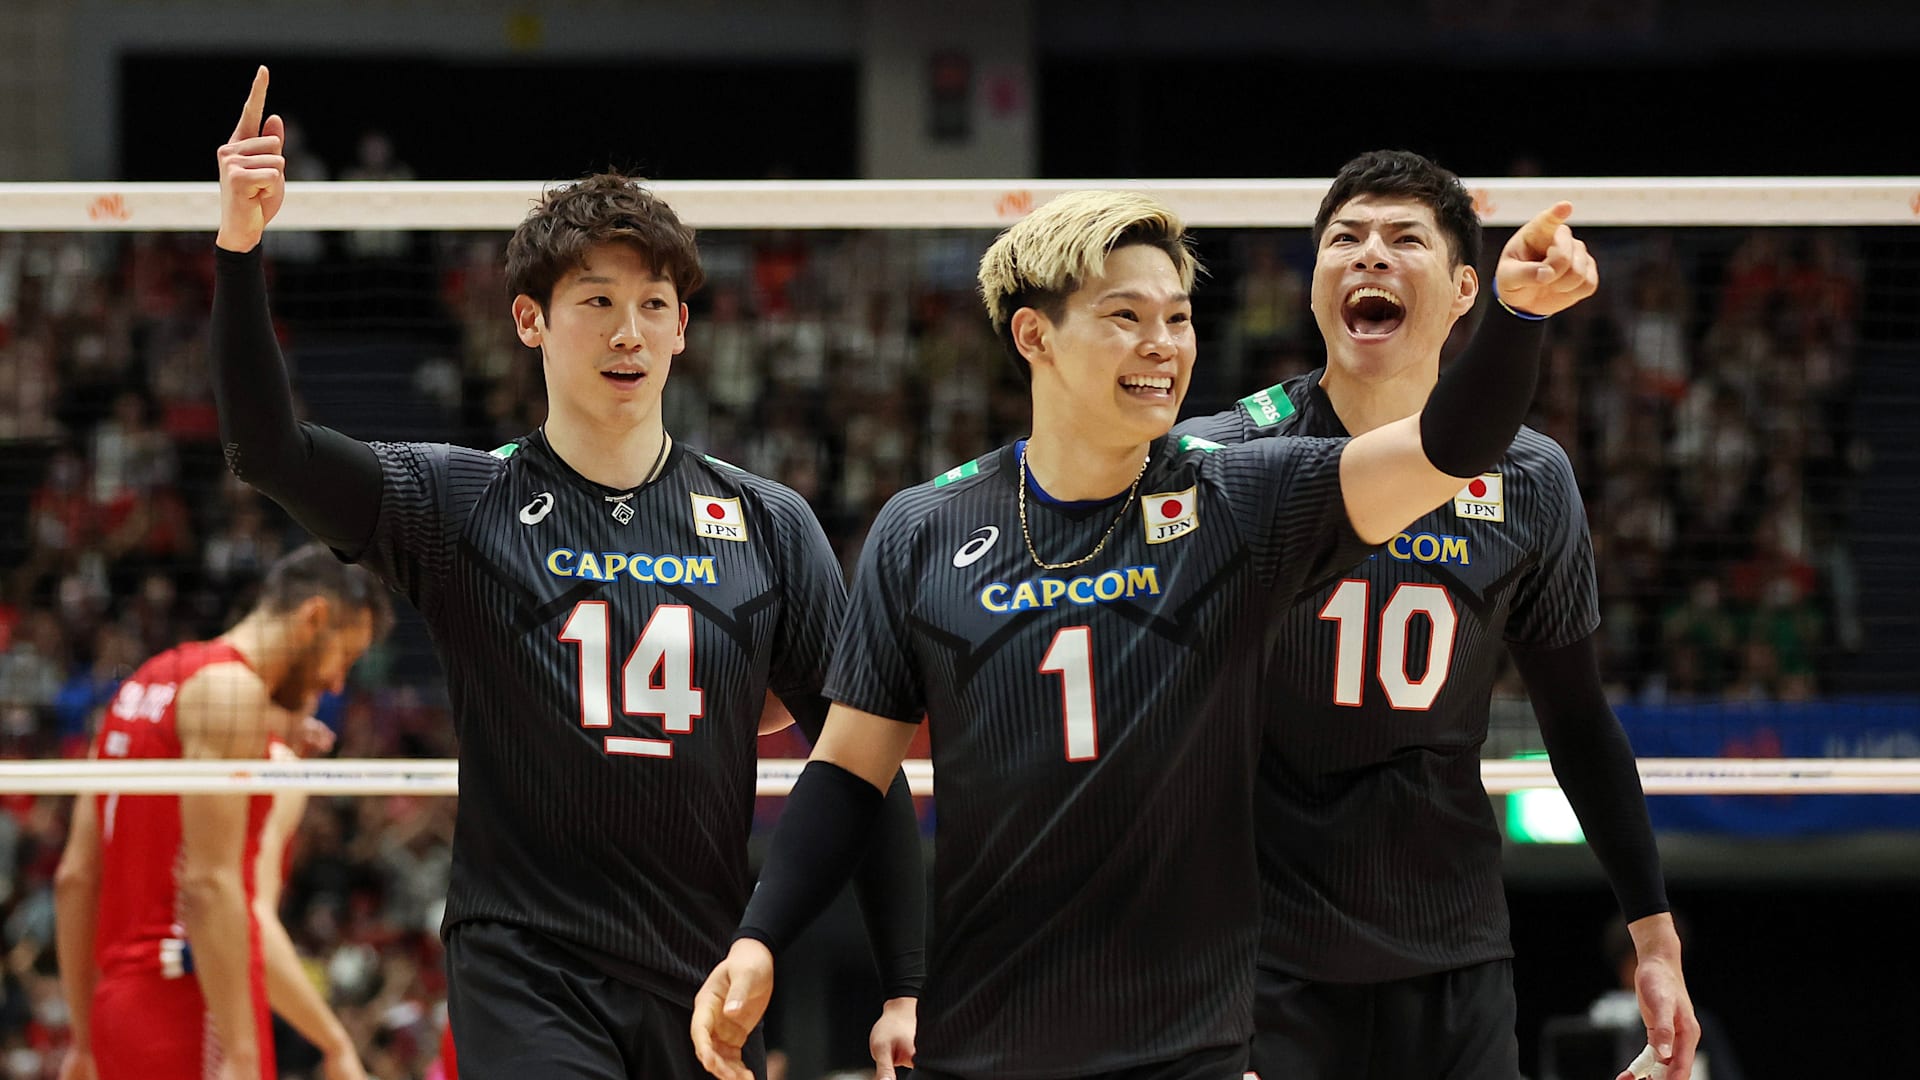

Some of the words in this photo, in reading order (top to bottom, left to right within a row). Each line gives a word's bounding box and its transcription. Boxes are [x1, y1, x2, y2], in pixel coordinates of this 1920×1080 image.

[1157, 518, 1191, 539] JPN
[1464, 503, 1496, 517] JPN
[705, 523, 737, 537] JPN
[546, 549, 719, 586] CAPCOM
[1370, 532, 1472, 566] COM
[979, 565, 1162, 613] CAPCOM
[1318, 578, 1459, 711] 10
[558, 600, 705, 735] 14
[1038, 625, 1099, 763] 1
